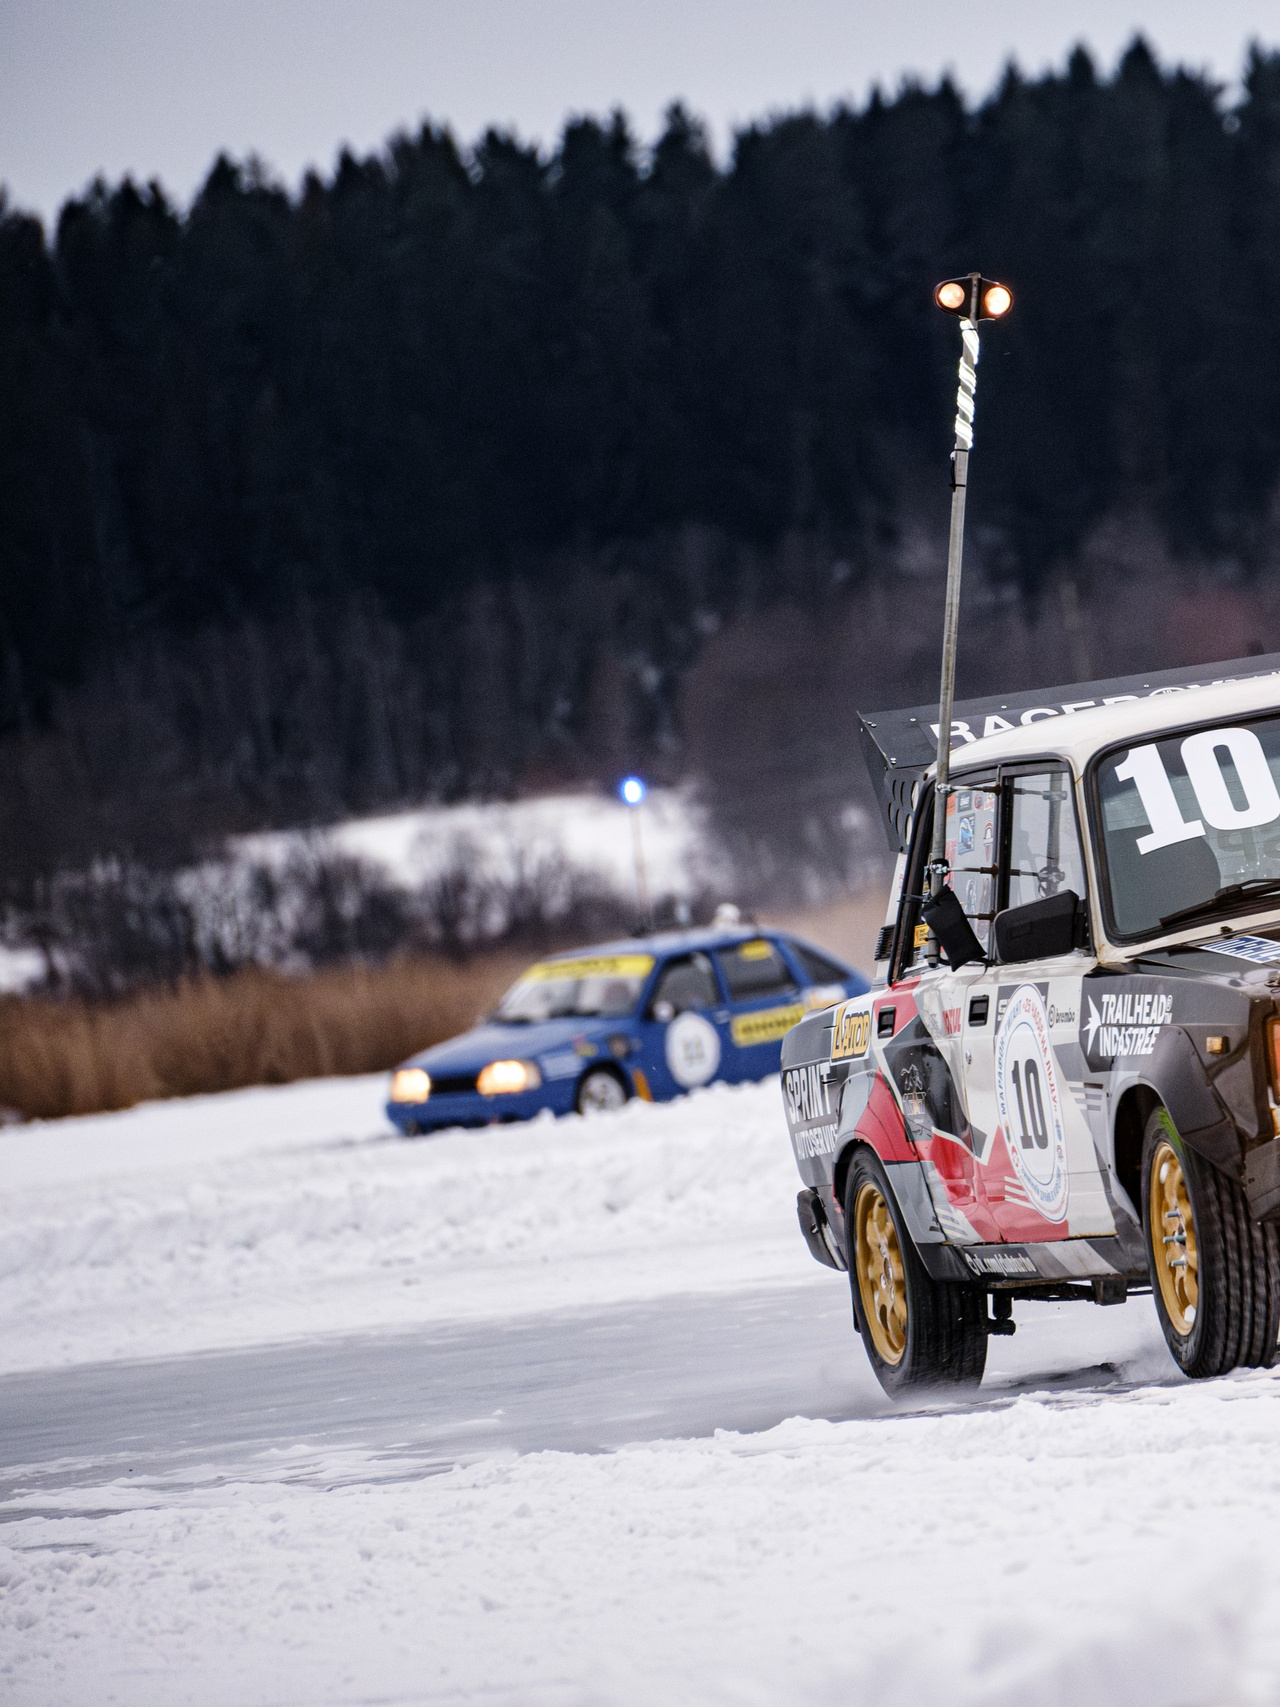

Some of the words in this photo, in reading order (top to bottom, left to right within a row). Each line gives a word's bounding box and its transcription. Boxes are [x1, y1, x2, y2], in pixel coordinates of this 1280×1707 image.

[1056, 1008, 1075, 1024] brembo
[785, 1061, 832, 1125] SPRINT
[1011, 1058, 1049, 1150] 10
